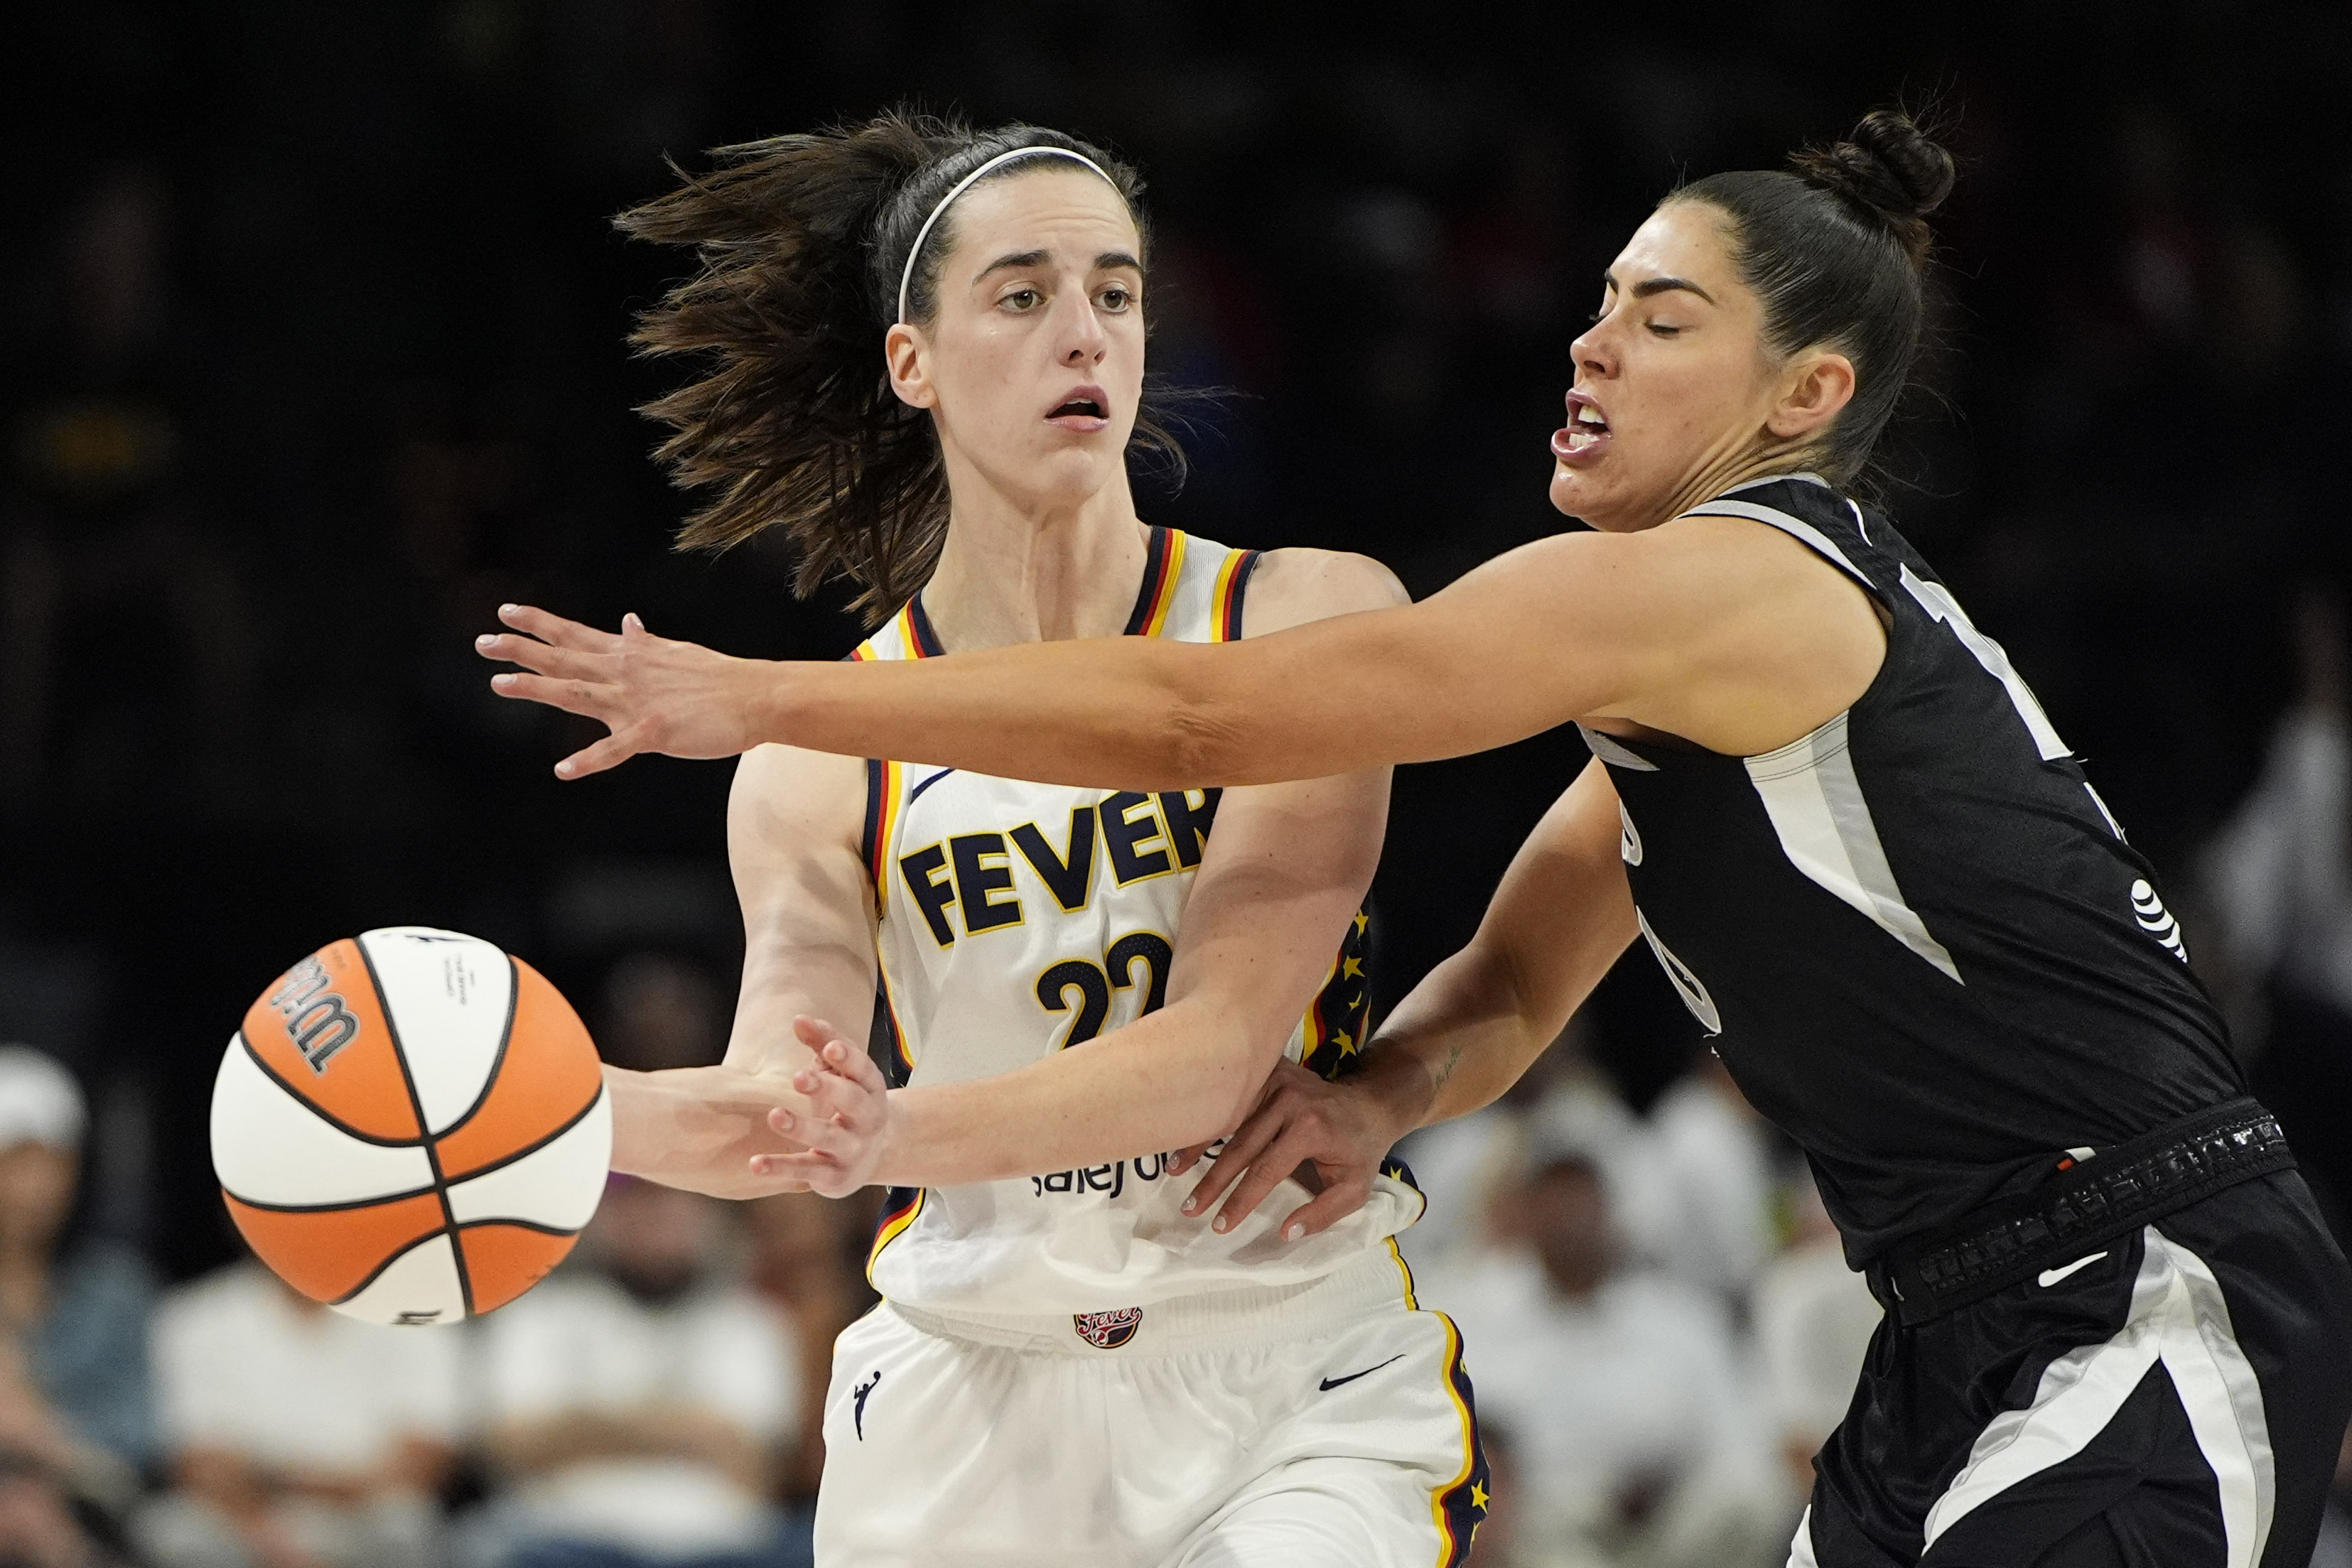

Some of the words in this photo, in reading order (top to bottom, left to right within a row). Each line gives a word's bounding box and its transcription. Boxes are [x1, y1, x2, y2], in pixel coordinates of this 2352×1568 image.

[898, 787, 1223, 949] FEVER
[1033, 929, 1174, 1051] 22
[1077, 1307, 1141, 1336] Fever
